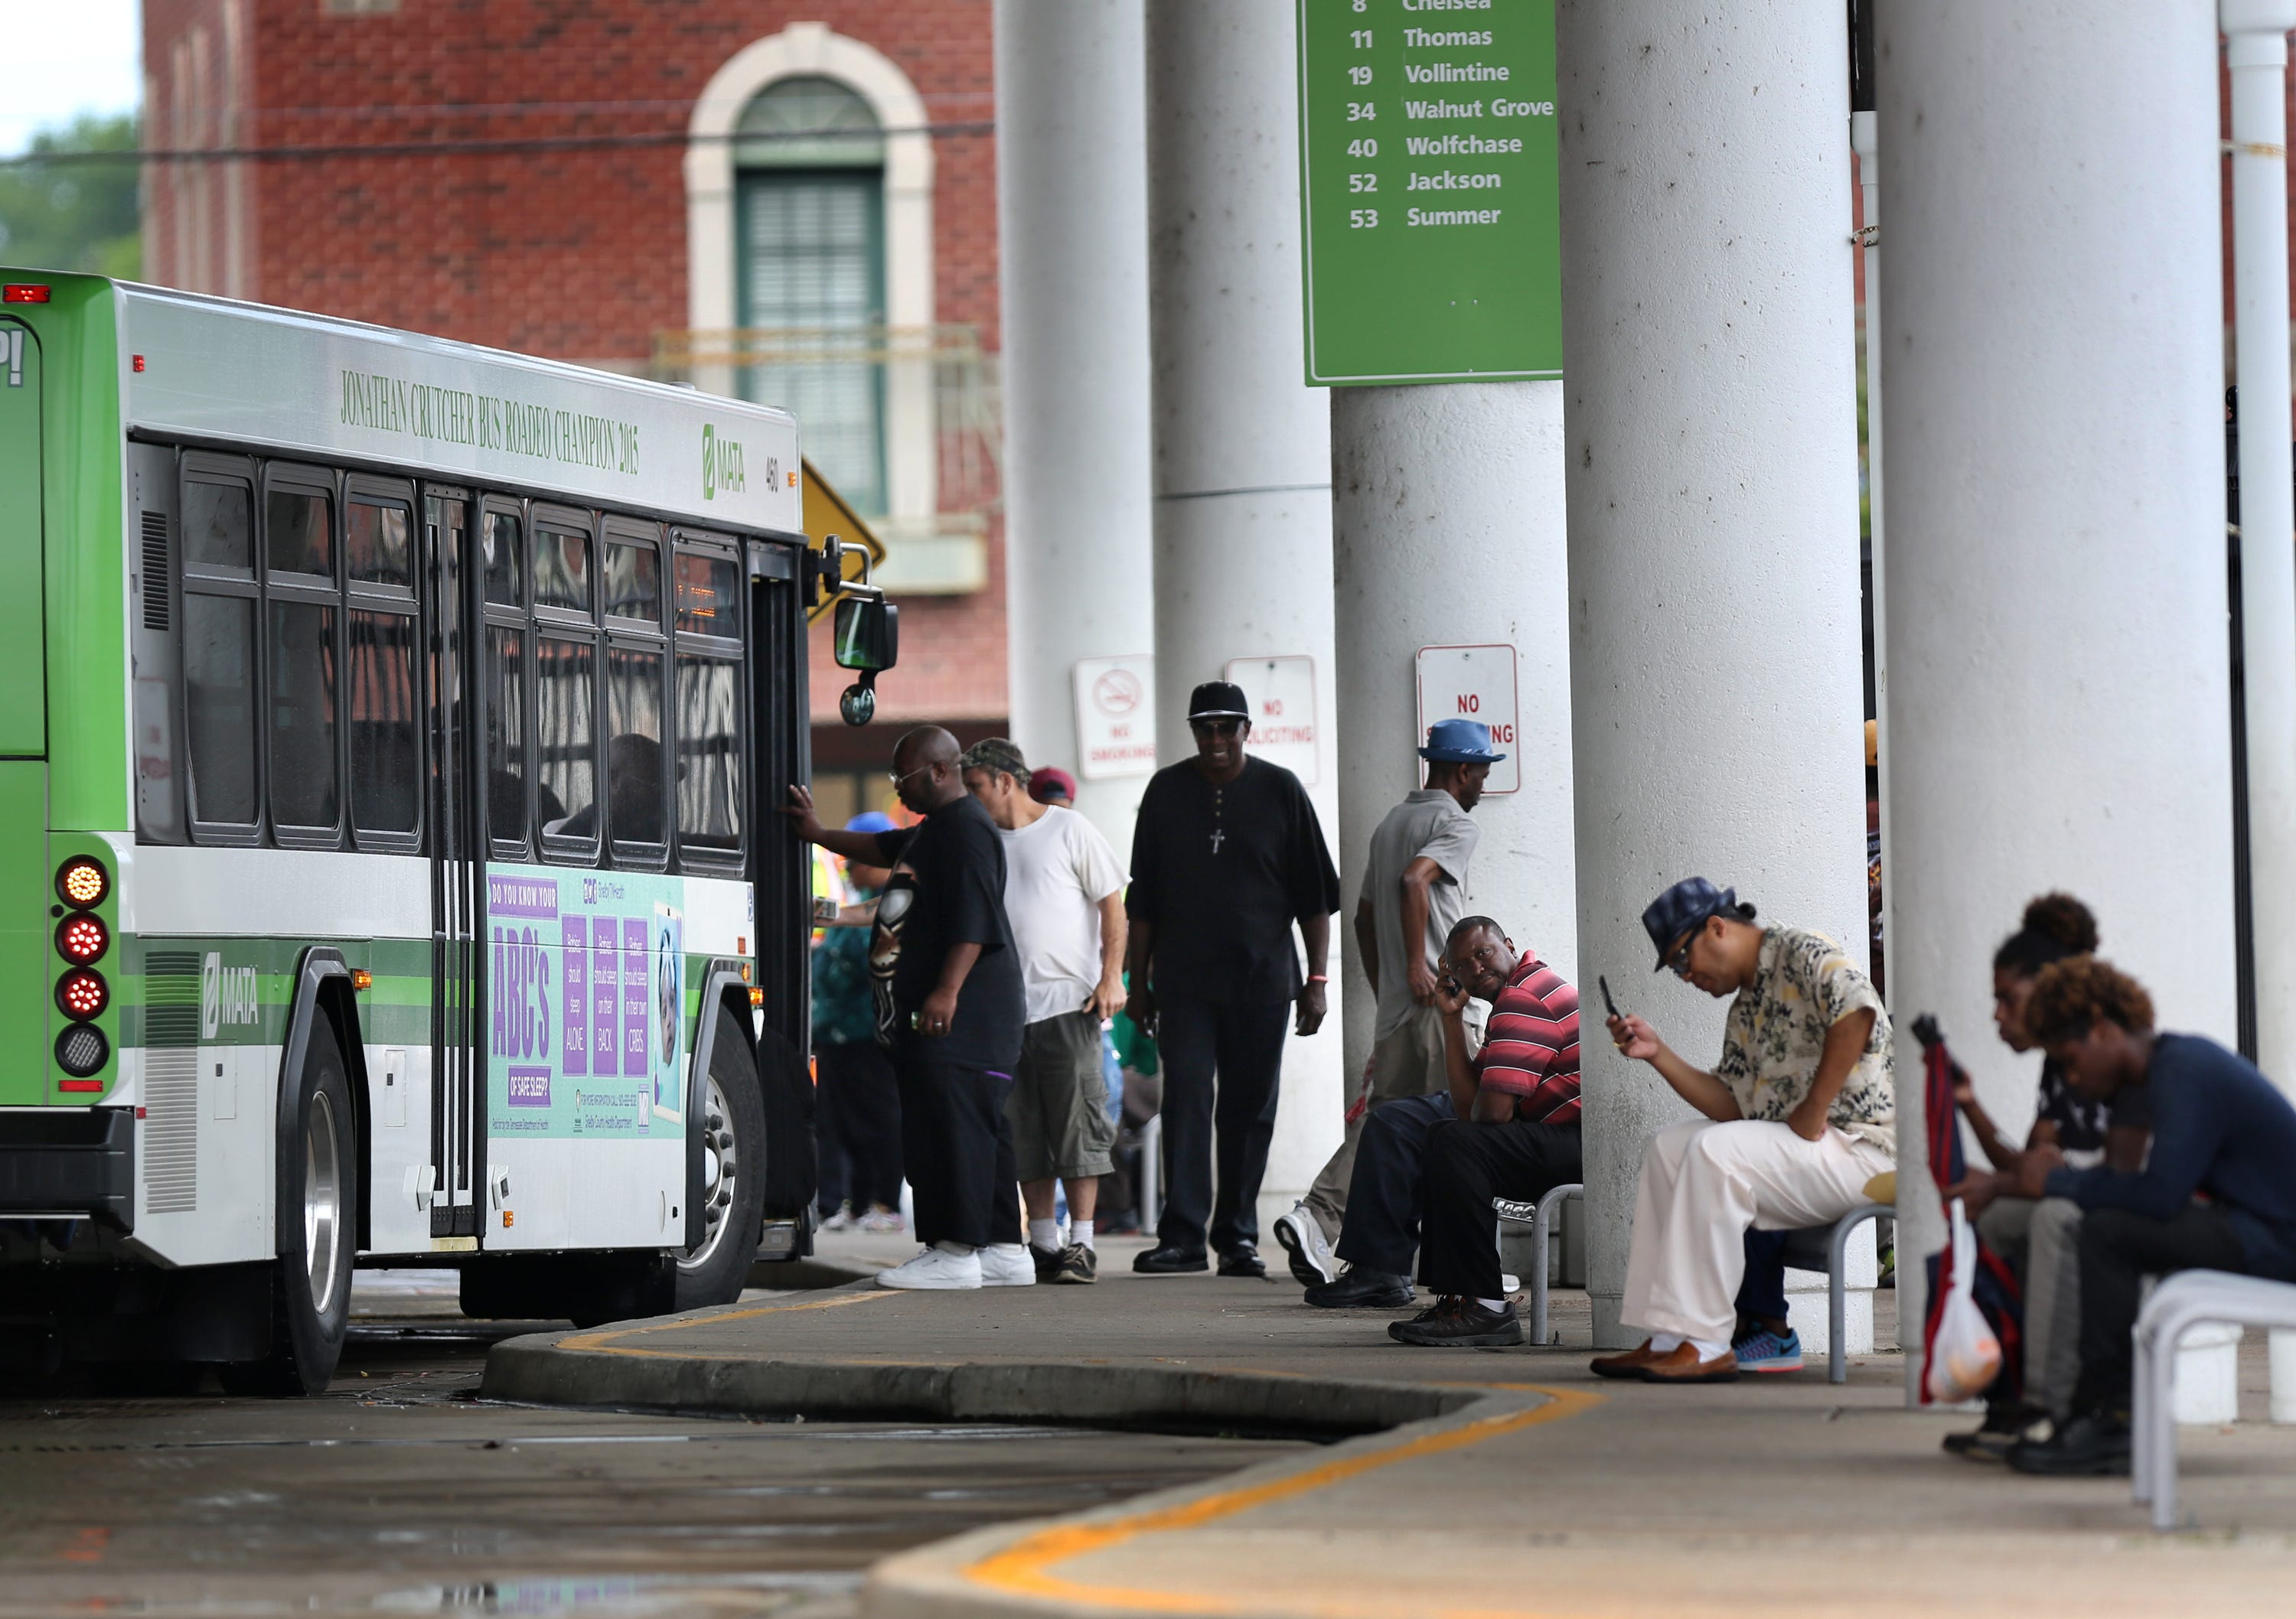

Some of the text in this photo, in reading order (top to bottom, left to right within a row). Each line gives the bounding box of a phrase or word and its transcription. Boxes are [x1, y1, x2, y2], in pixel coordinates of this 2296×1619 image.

[1350, 28, 1493, 48] 11 Thomas
[1347, 62, 1510, 85] 19 Vollintine
[1346, 99, 1554, 122] 34 Walnut Grove
[1347, 135, 1523, 158] 40 Wolfchase
[1349, 170, 1502, 193] 52 Jackson
[1350, 207, 1502, 229] 53 Summer
[341, 370, 639, 475] JONATHAN CRUTCHER BUS ROADEO CHAMPION 2015
[717, 438, 745, 494] MATA
[1263, 699, 1283, 715] NO
[1457, 694, 1479, 713] NO
[1110, 722, 1131, 739] NO
[1247, 726, 1313, 744] OLICITING
[492, 883, 556, 908] DO YOU KNOW YOUR
[222, 967, 259, 1024] MATA
[510, 1076, 548, 1096] OF SAFE SLEEP?
